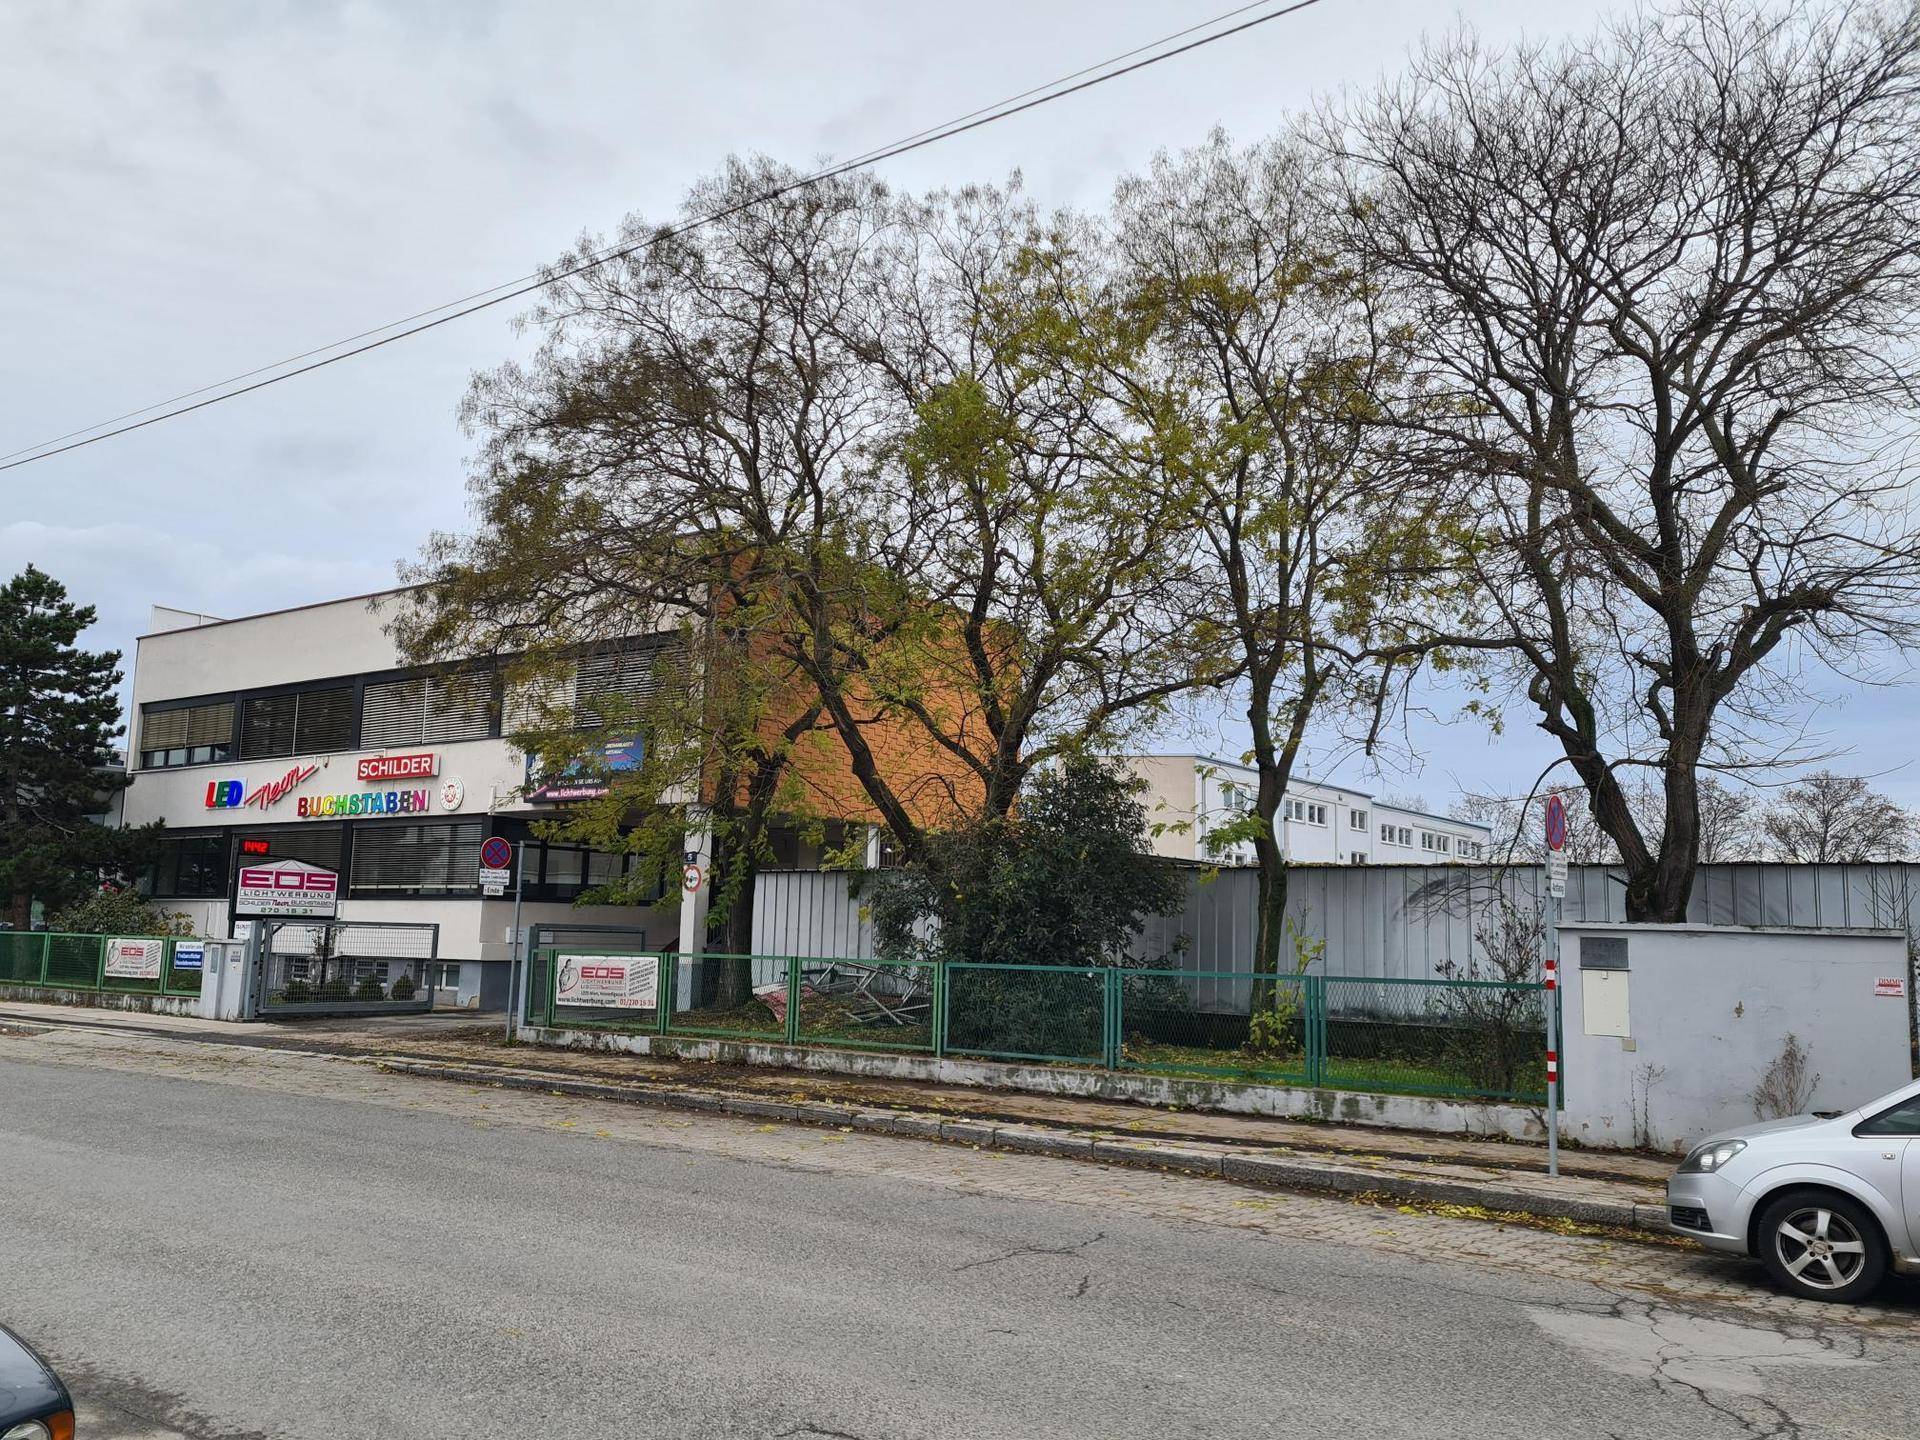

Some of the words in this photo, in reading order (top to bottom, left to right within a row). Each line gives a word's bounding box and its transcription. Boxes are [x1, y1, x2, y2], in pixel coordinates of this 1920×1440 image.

[360, 757, 431, 777] SCHILDER
[204, 779, 245, 808] LED
[246, 764, 316, 810] Neon
[546, 788, 609, 797] www.lichtwerbung.com
[297, 789, 429, 817] BUCHSTABEN
[240, 869, 336, 891] EOS
[243, 890, 331, 899] LICHTWERBUNG
[238, 899, 271, 907] SCHILDER
[271, 899, 289, 907] Neon
[581, 967, 625, 979] EOS
[557, 997, 616, 1005] www.lichtwerbung.com
